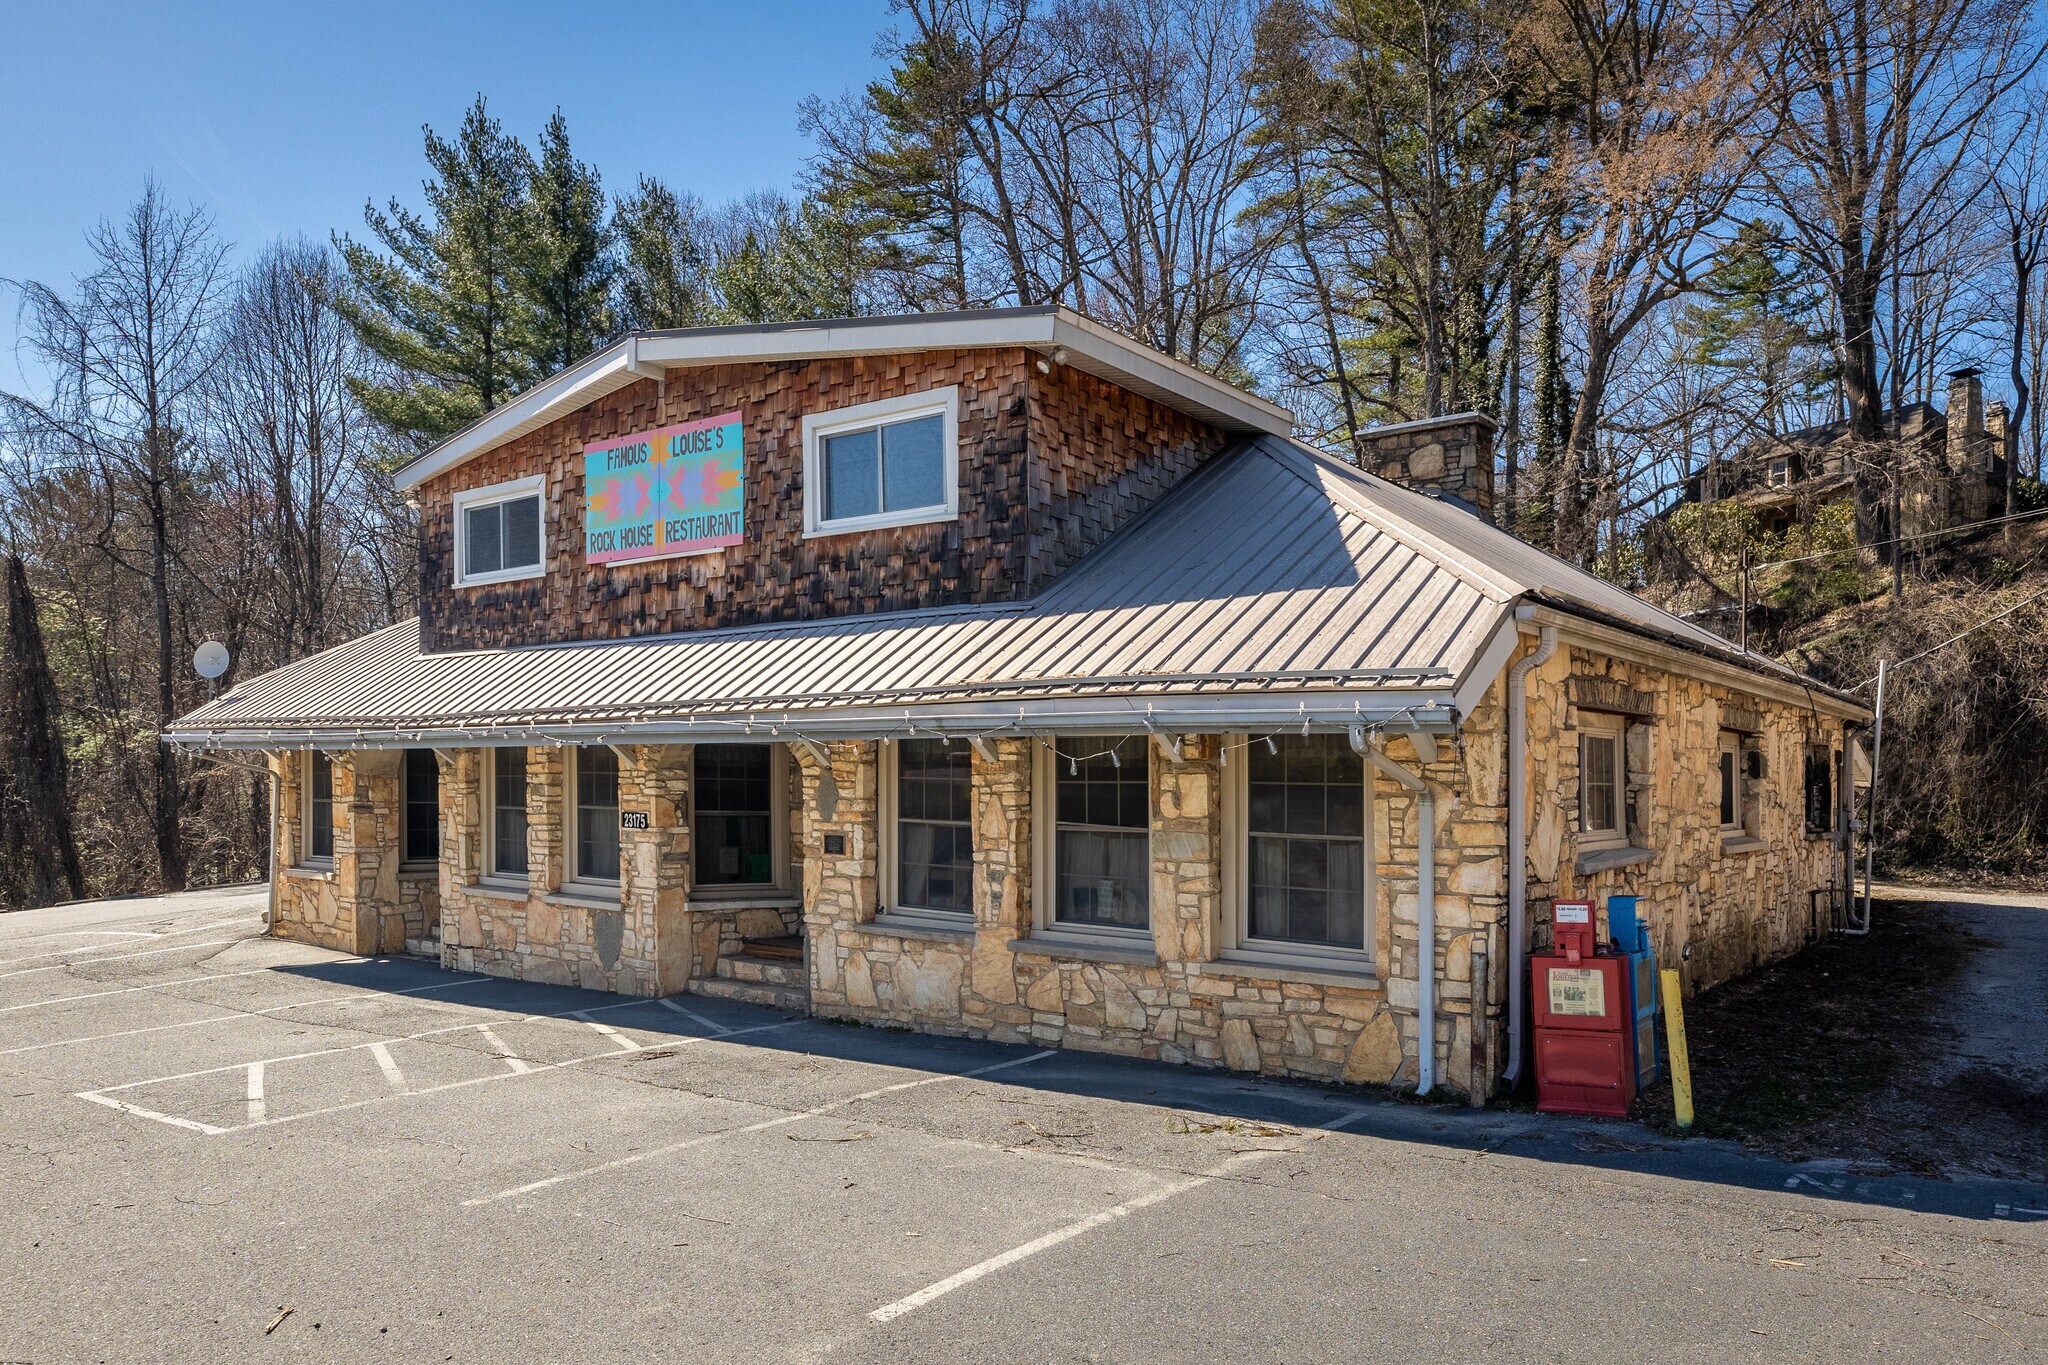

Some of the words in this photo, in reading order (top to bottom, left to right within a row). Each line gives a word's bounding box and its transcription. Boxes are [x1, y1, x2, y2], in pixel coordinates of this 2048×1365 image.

[607, 442, 647, 470] FAMOUS
[590, 530, 616, 554] ROCK
[620, 524, 653, 550] HOUSE
[665, 511, 741, 543] RESTAURANT
[624, 813, 646, 828] 23175
[1552, 971, 1579, 981] Journal
